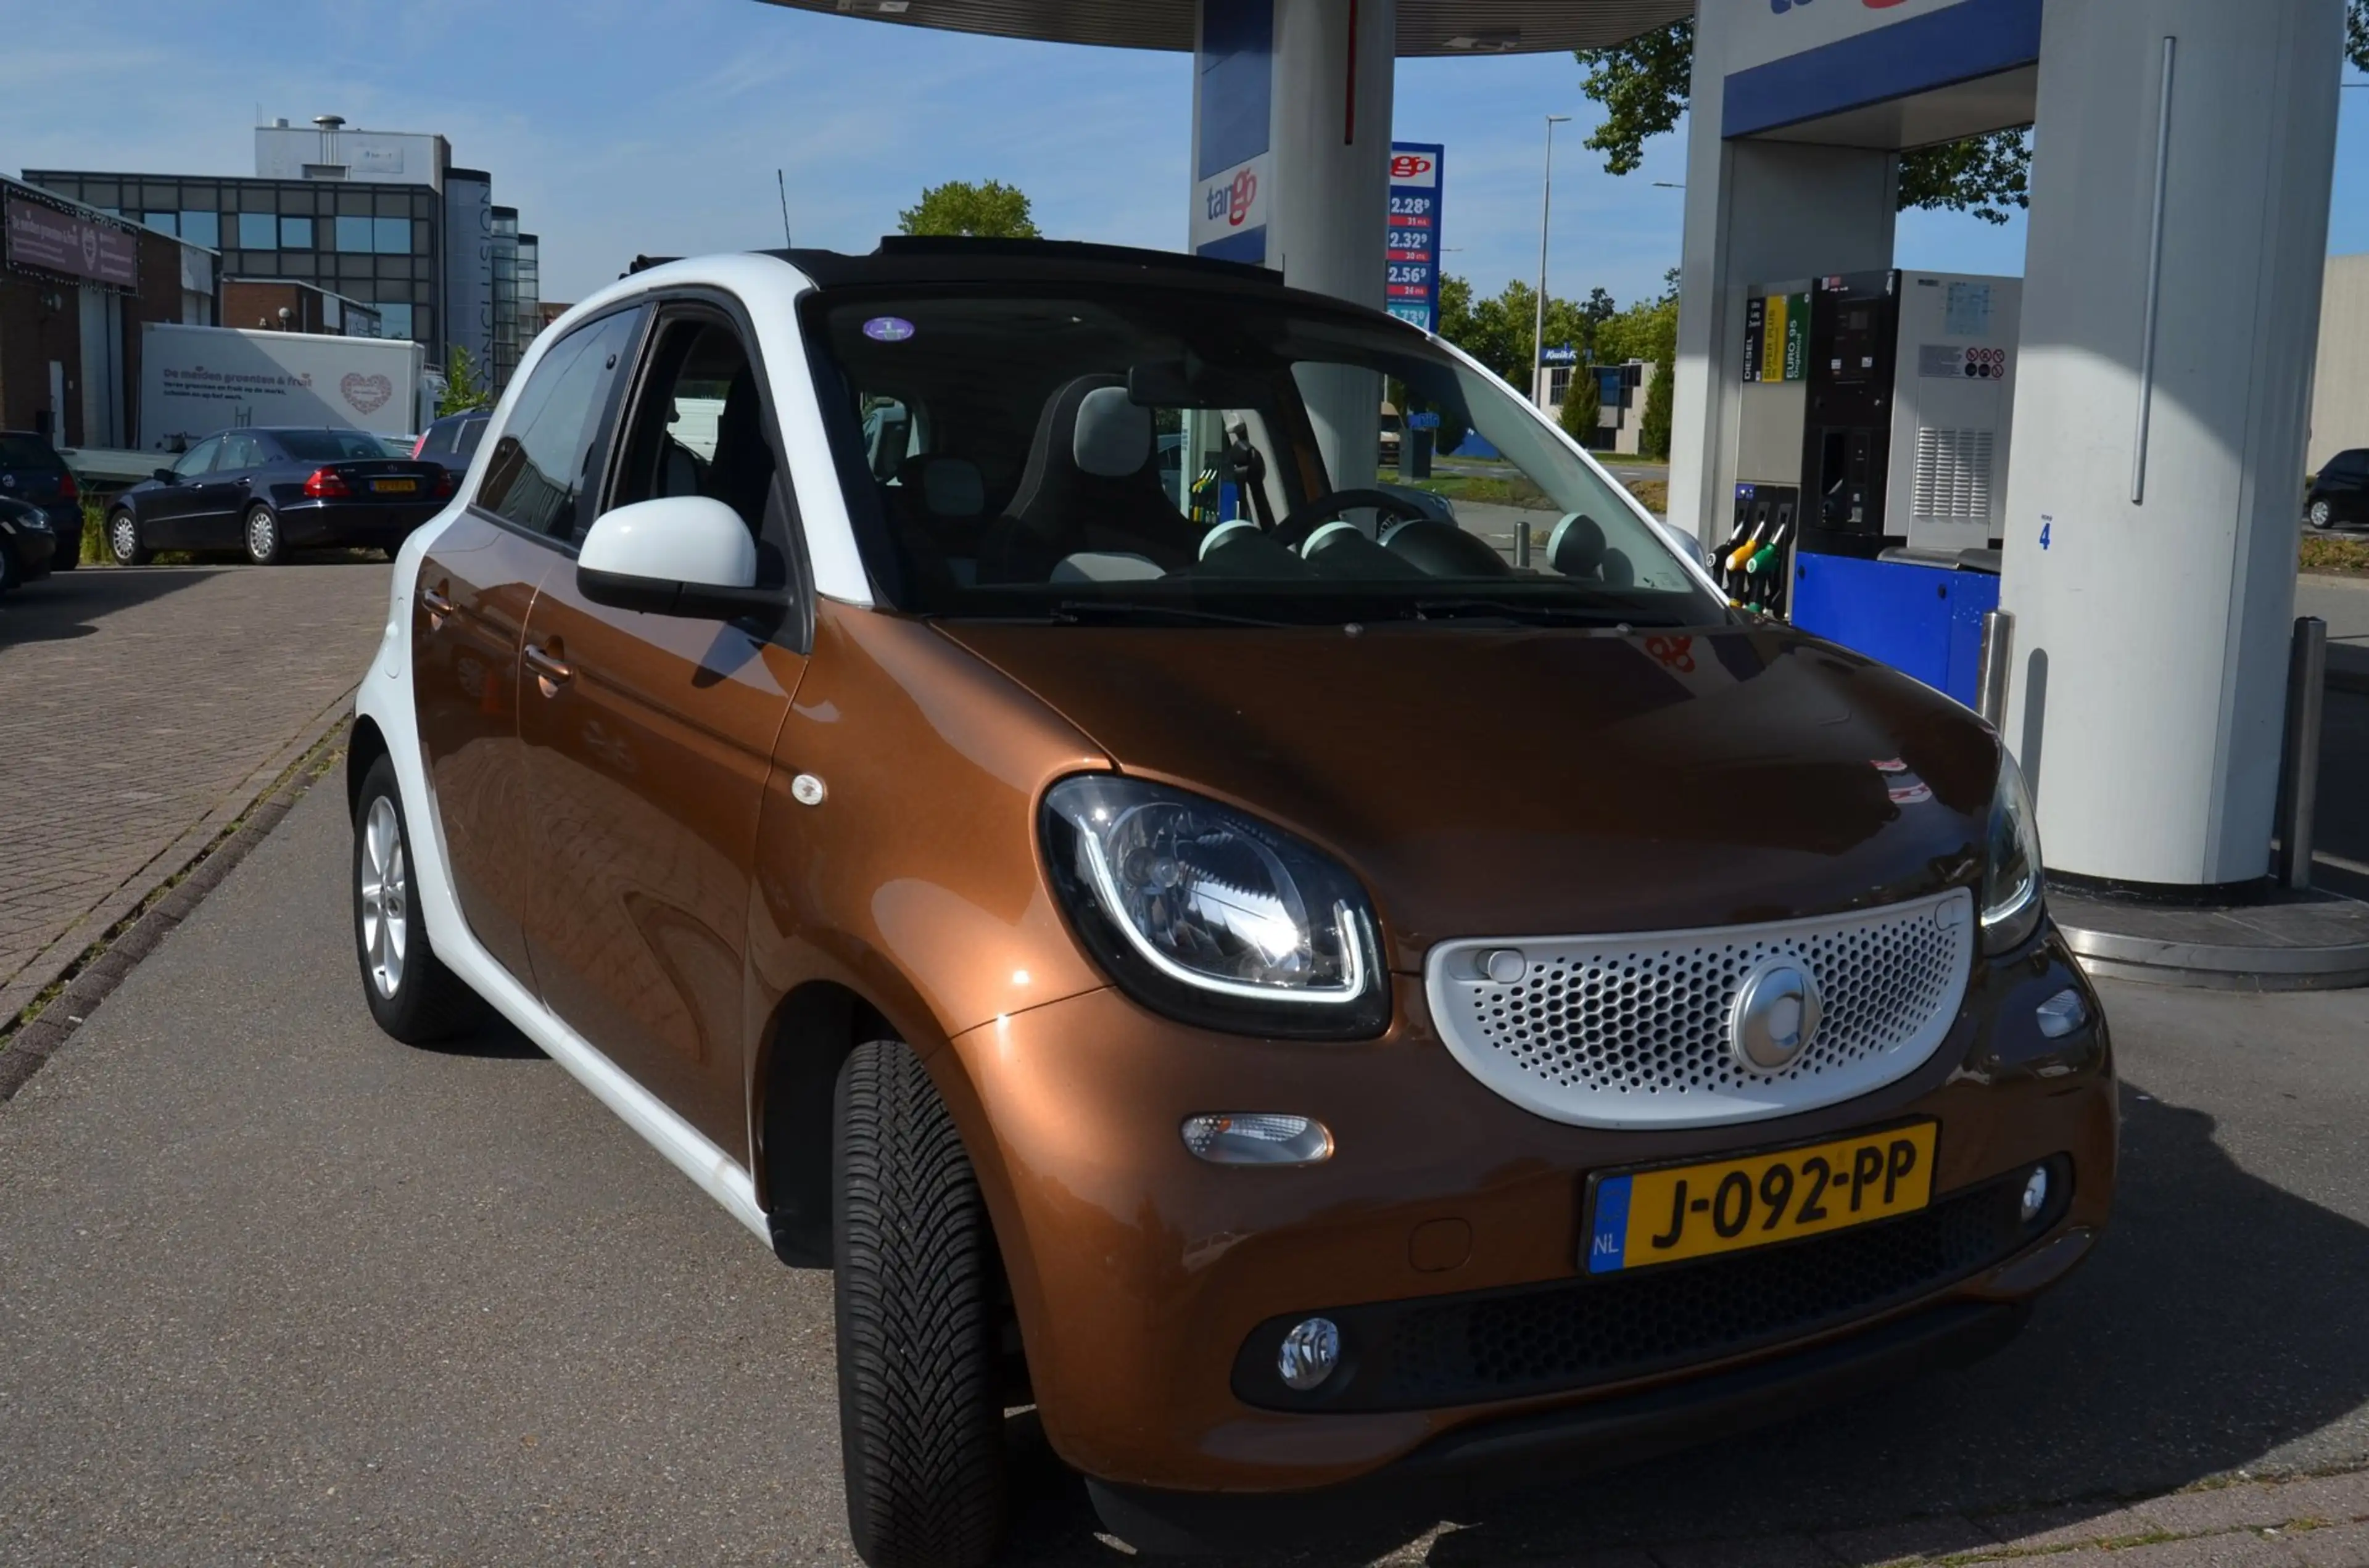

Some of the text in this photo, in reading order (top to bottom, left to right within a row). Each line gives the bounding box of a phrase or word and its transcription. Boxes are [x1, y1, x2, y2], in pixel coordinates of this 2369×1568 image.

[1207, 167, 1257, 226] tango
[1886, 277, 1893, 295] 4
[1745, 335, 1753, 379] DIESEL
[1787, 320, 1797, 378] EURO 95
[225, 373, 275, 384] groenten
[287, 373, 312, 387] fruit
[2040, 523, 2051, 550] 4
[1652, 1140, 1916, 1249] J-092-PP
[1594, 1234, 1619, 1255] NL
